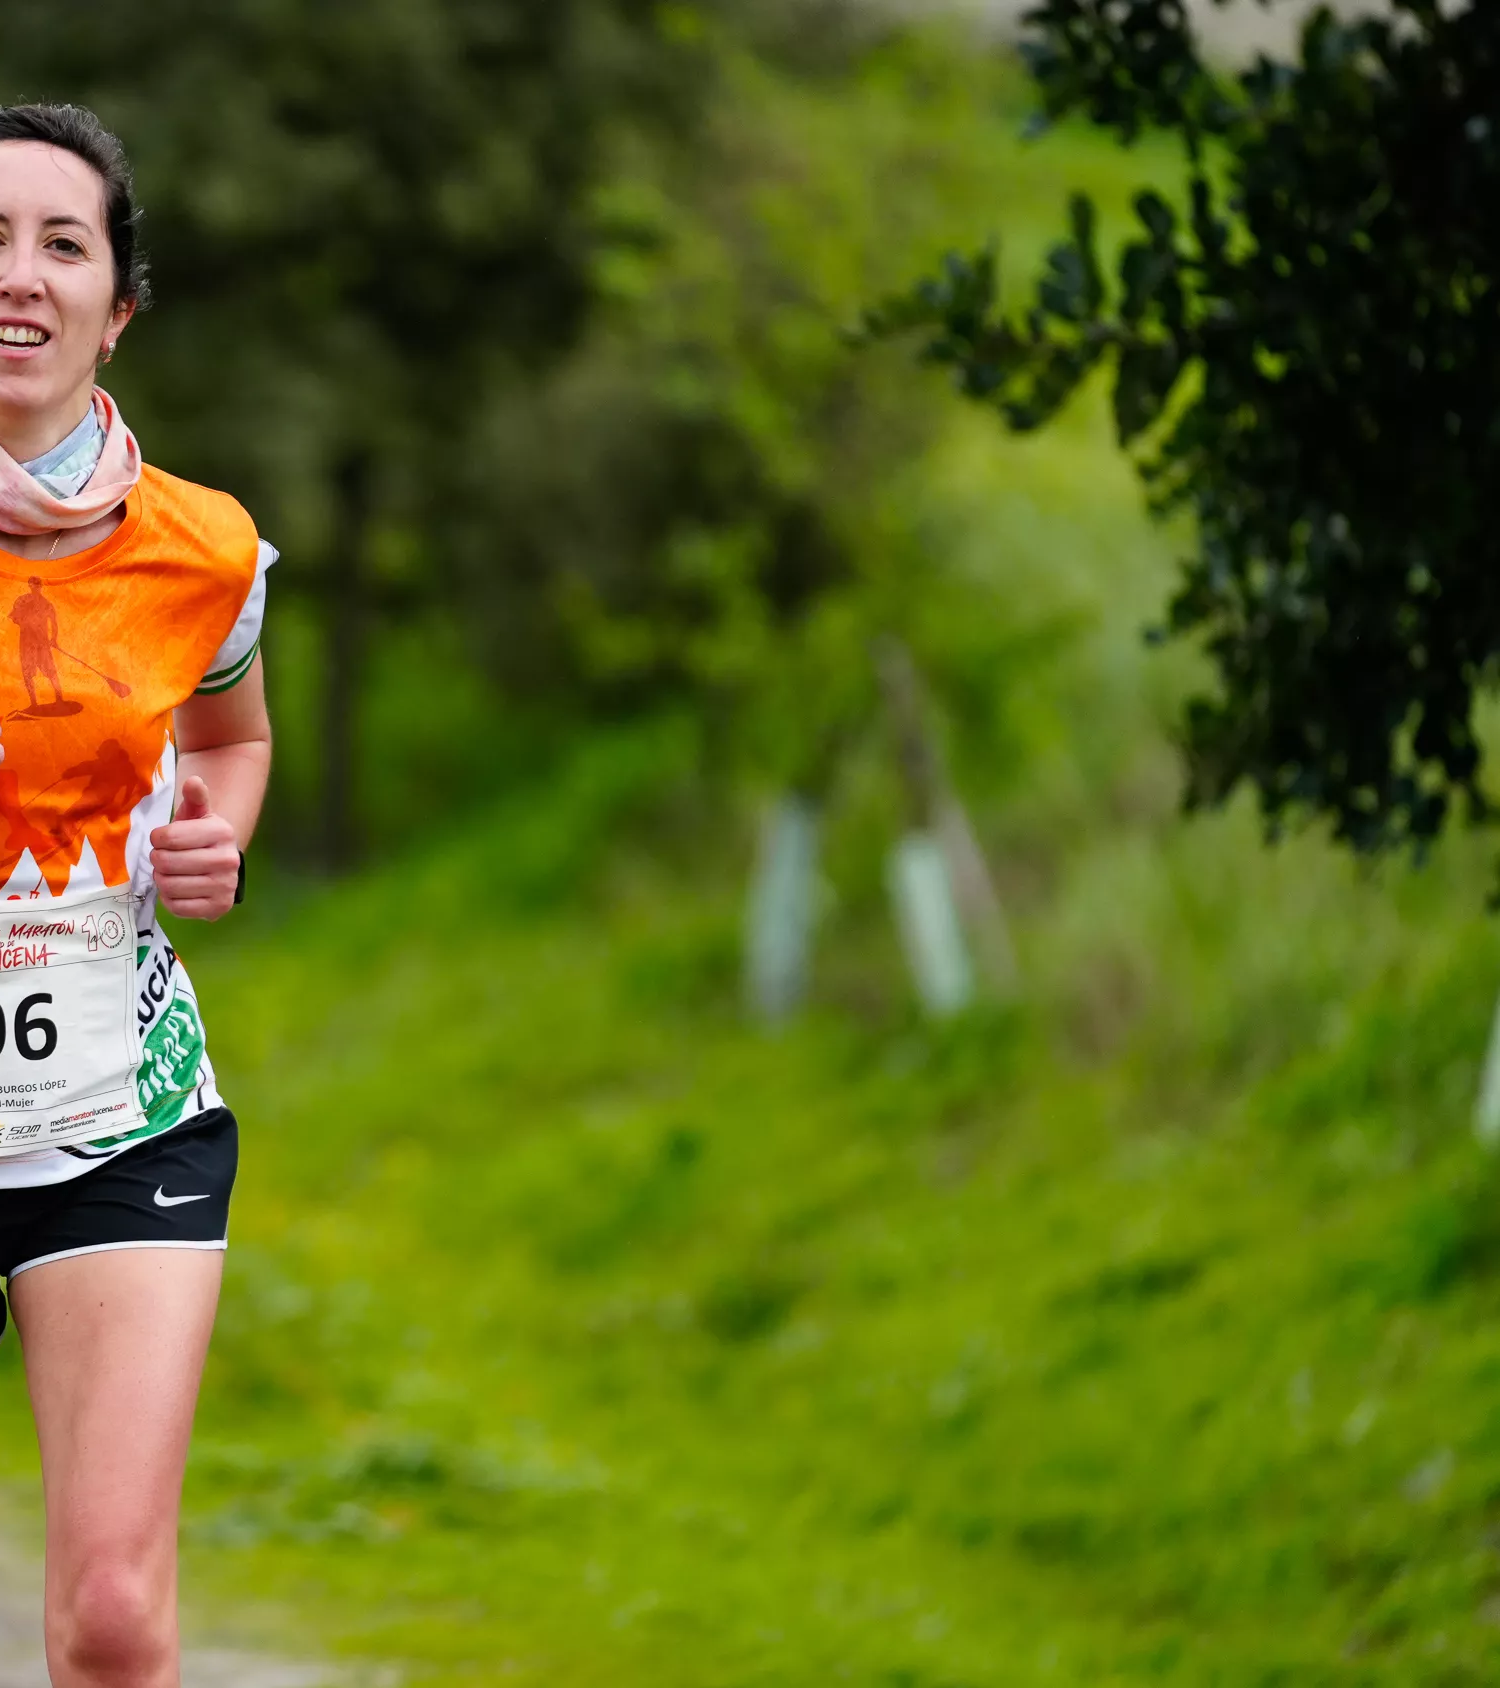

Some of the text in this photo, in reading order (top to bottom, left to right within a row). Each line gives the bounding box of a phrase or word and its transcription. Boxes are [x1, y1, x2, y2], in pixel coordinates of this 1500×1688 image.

[8, 919, 75, 940] MARATÓN
[39, 1079, 67, 1091] LÓPEZ
[50, 1102, 127, 1126] mediamaratonlucena.com
